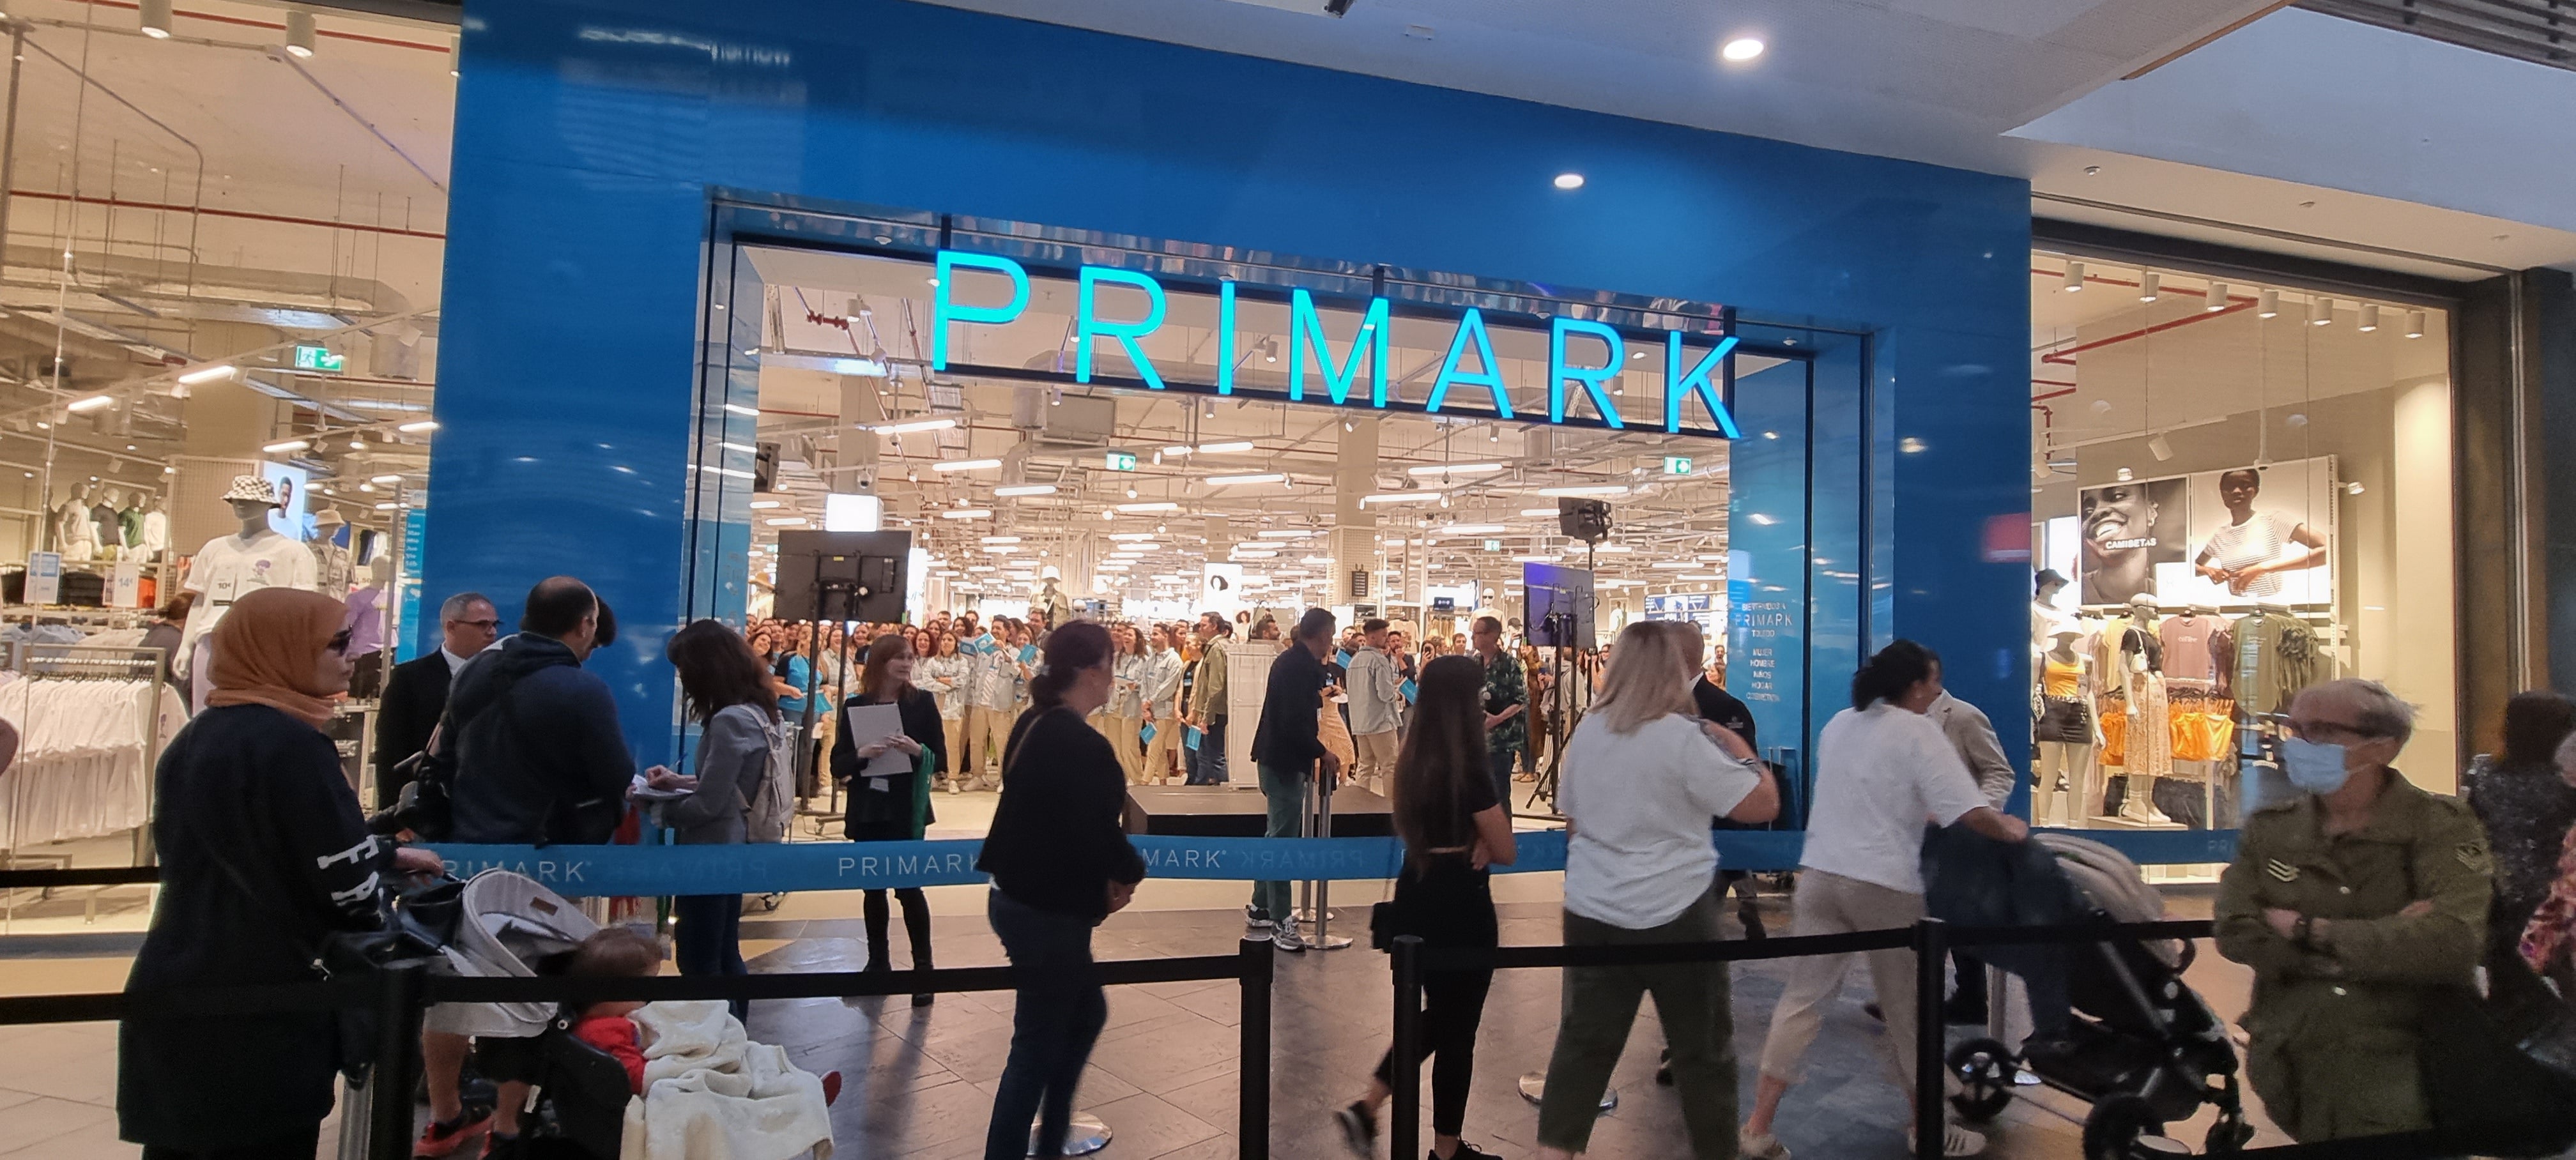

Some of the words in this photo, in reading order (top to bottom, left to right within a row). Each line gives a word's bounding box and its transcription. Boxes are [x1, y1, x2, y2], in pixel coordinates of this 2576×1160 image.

[933, 250, 1740, 439] PRIMARK
[2105, 537, 2157, 549] CAMISETAS
[1735, 613, 1793, 627] PRIMARK
[1142, 848, 1221, 868] MARK
